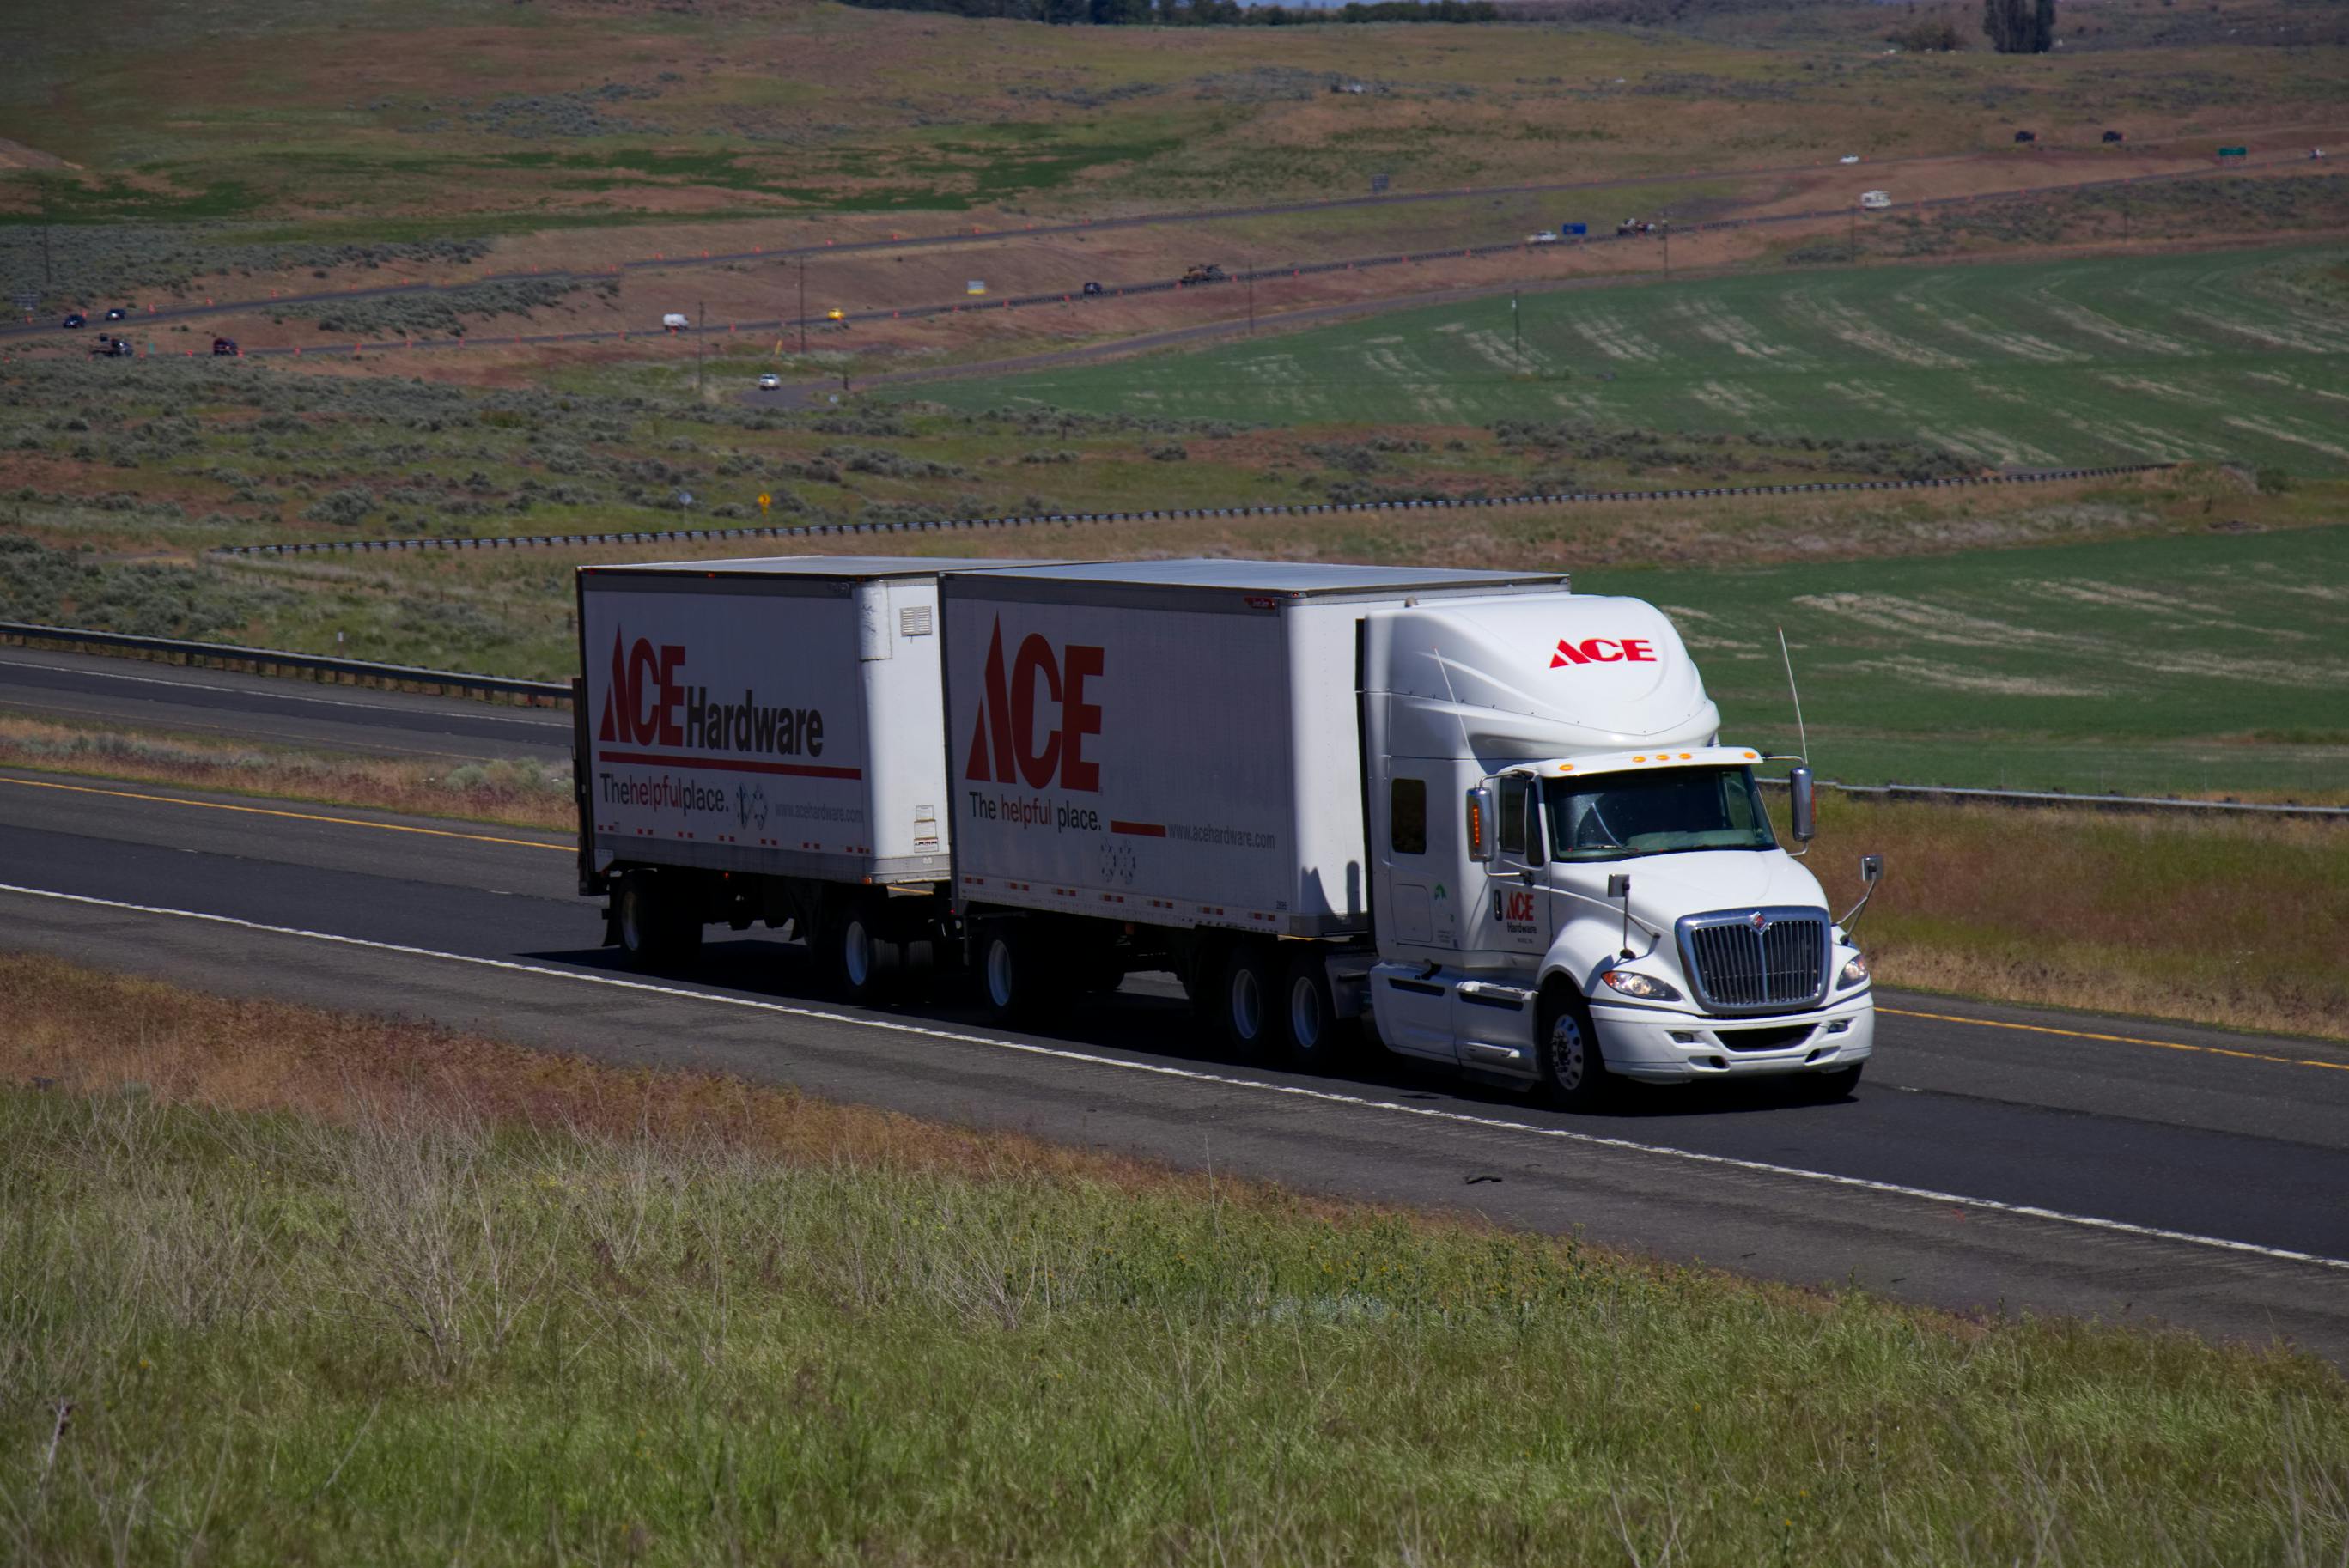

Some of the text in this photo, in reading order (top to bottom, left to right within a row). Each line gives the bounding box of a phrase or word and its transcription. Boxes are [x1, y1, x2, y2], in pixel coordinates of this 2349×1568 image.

[1549, 638, 1658, 669] ACE
[599, 623, 824, 757] ACE Hardware
[965, 610, 1105, 793] ACE
[969, 791, 1102, 833] The helpful place.
[1168, 823, 1276, 850] www.acehardware.com
[1505, 890, 1535, 921] ACE
[1507, 921, 1537, 933] Hardware
